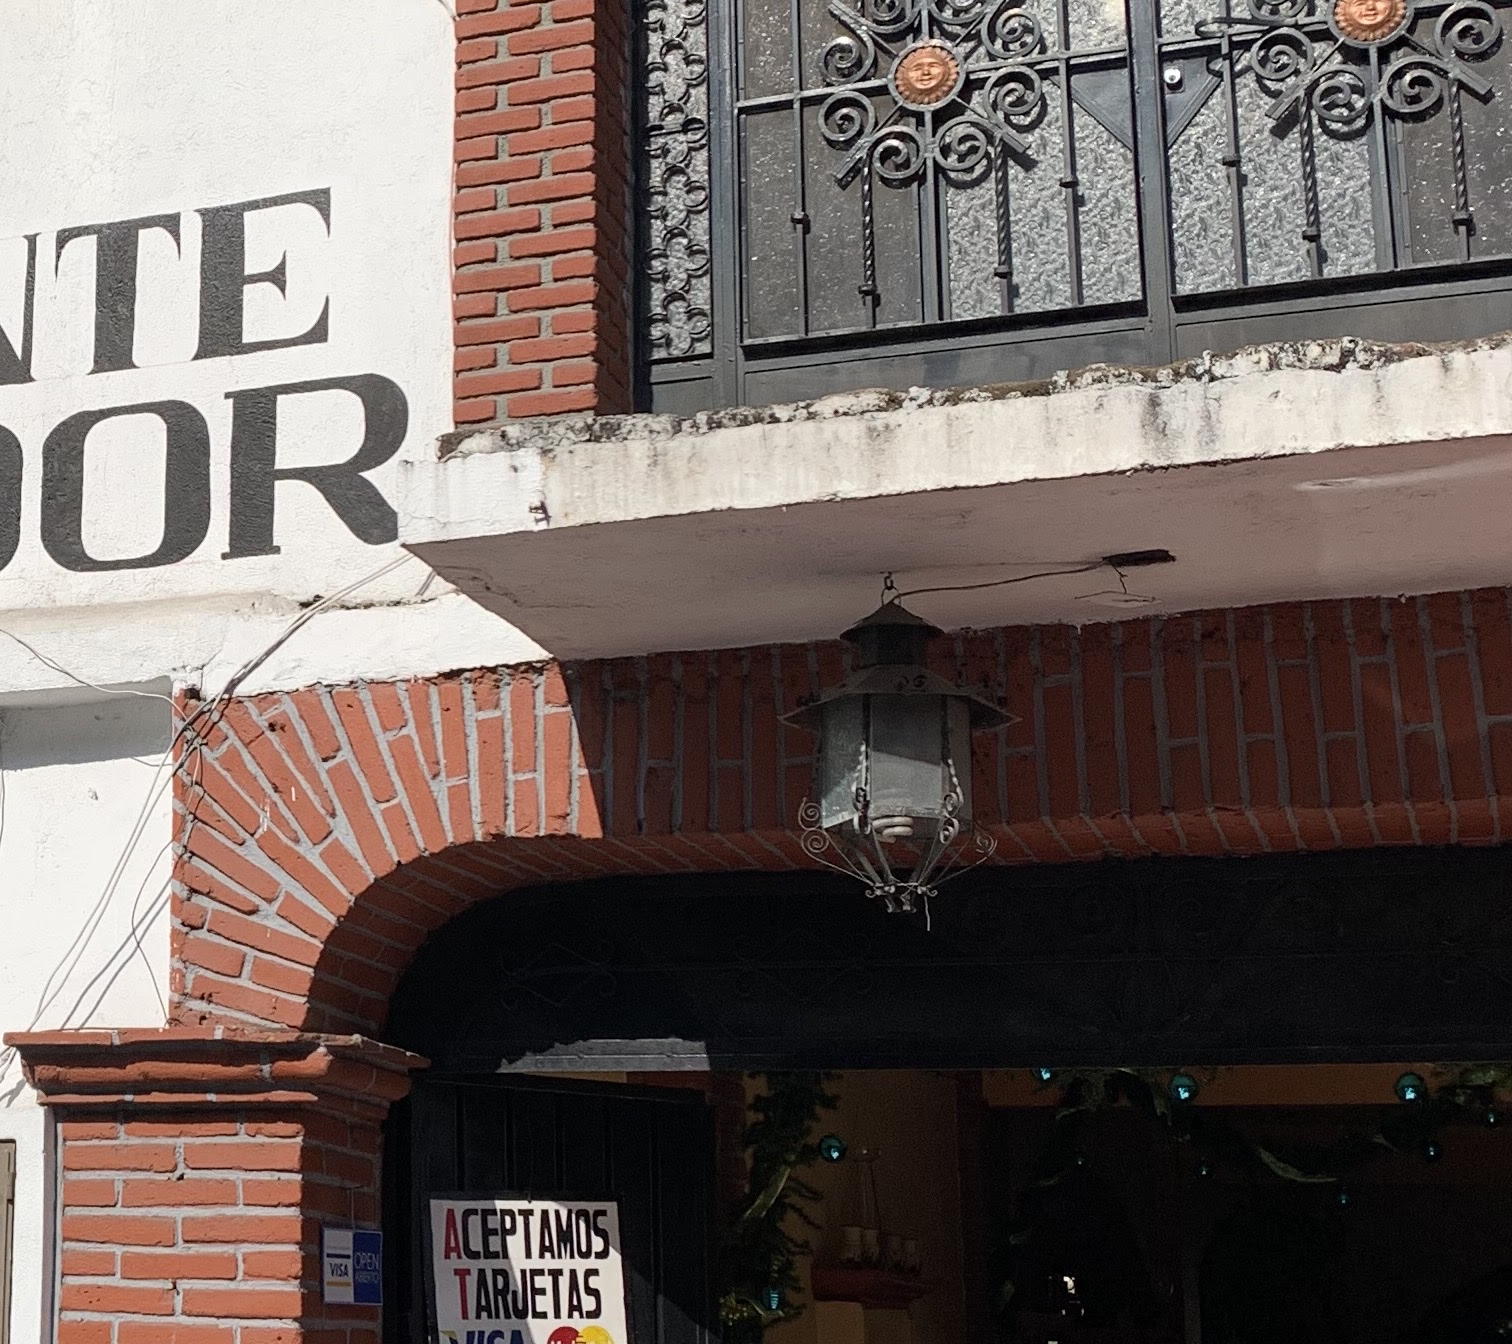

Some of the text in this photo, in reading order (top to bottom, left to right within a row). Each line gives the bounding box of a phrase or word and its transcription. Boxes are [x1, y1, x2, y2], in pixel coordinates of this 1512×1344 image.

[443, 1208, 610, 1260] ACEPTAMOS
[329, 1262, 349, 1278] VISA
[354, 1252, 380, 1269] OPEN
[453, 1268, 602, 1320] TARJETAS
